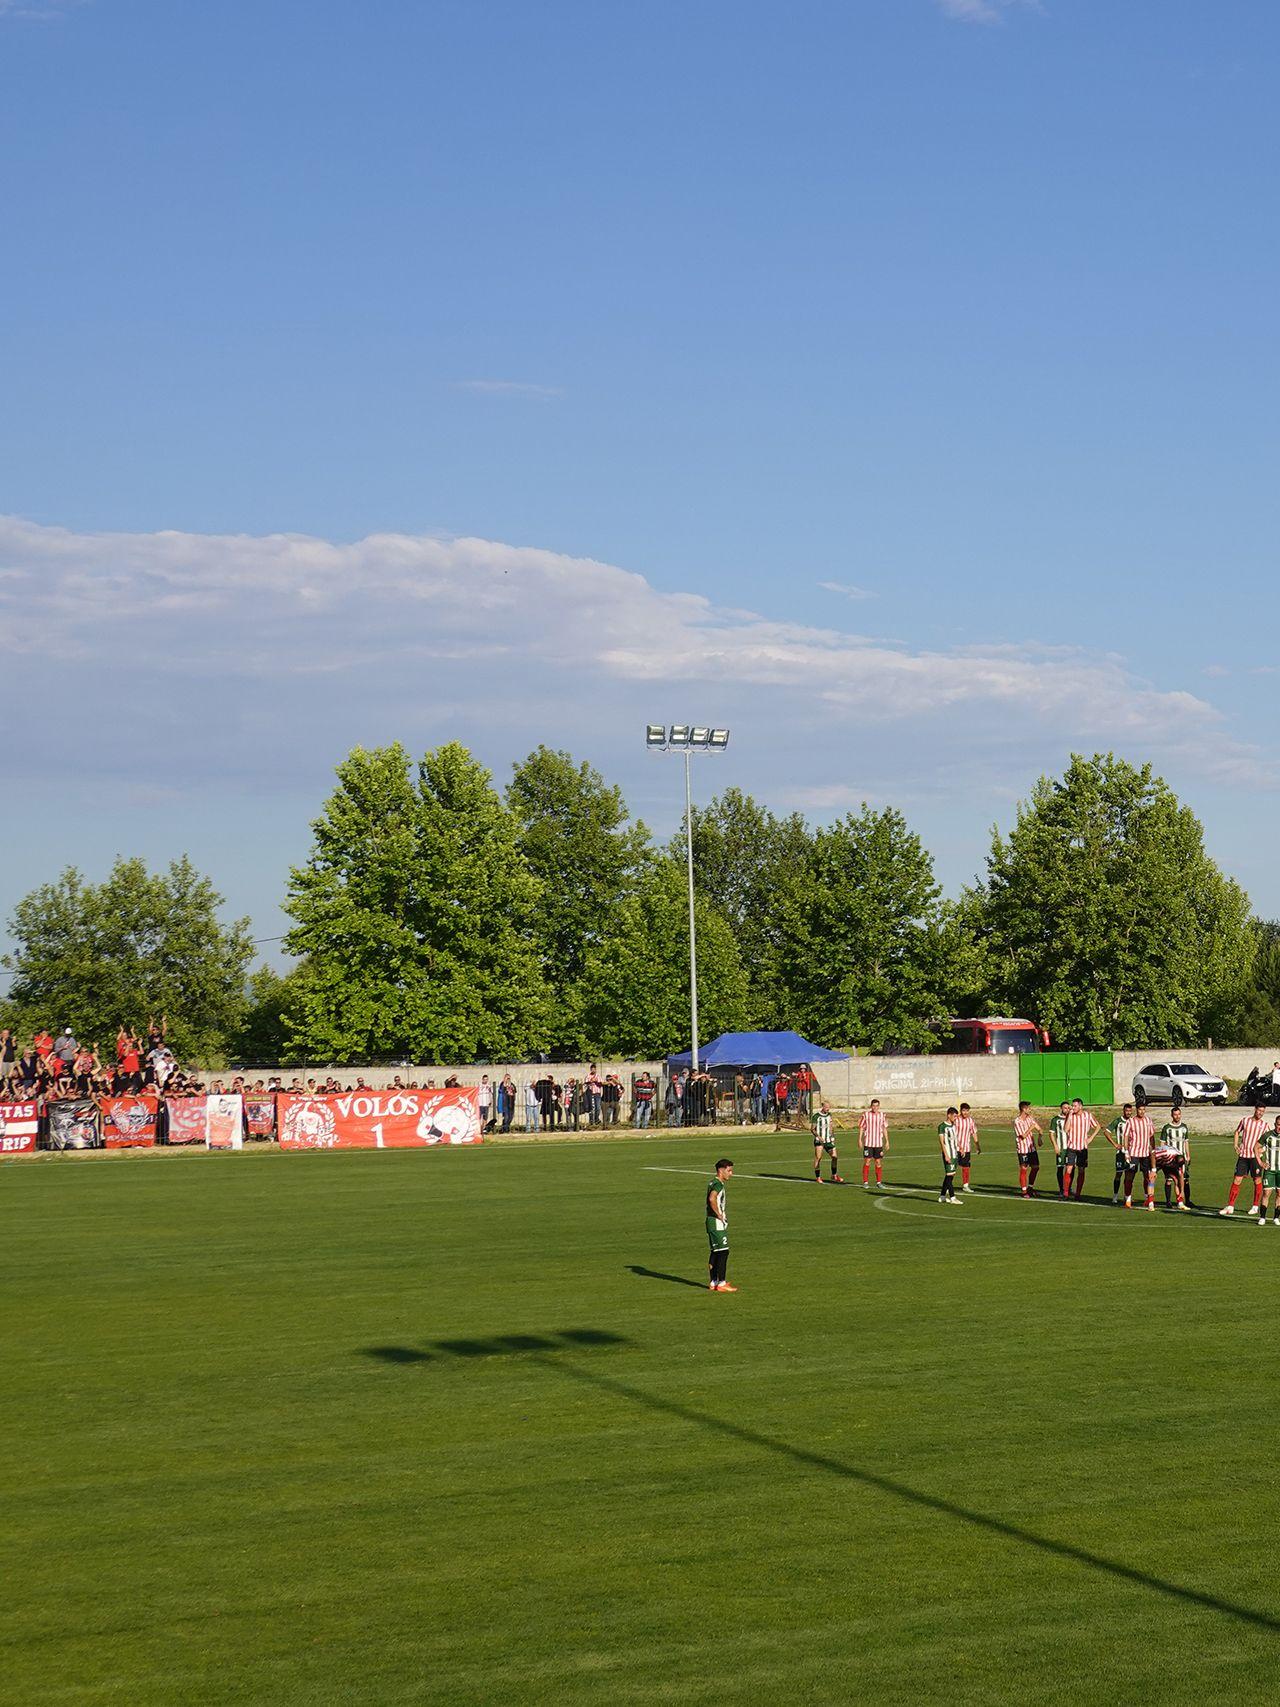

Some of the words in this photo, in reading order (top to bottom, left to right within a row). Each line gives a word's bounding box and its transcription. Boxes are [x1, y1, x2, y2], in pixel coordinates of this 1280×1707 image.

[873, 1079, 918, 1090] ORIGINAL
[335, 1095, 418, 1118] VOLOS
[371, 1122, 386, 1148] 1
[0, 1136, 31, 1151] RIP
[722, 1236, 728, 1245] 2
